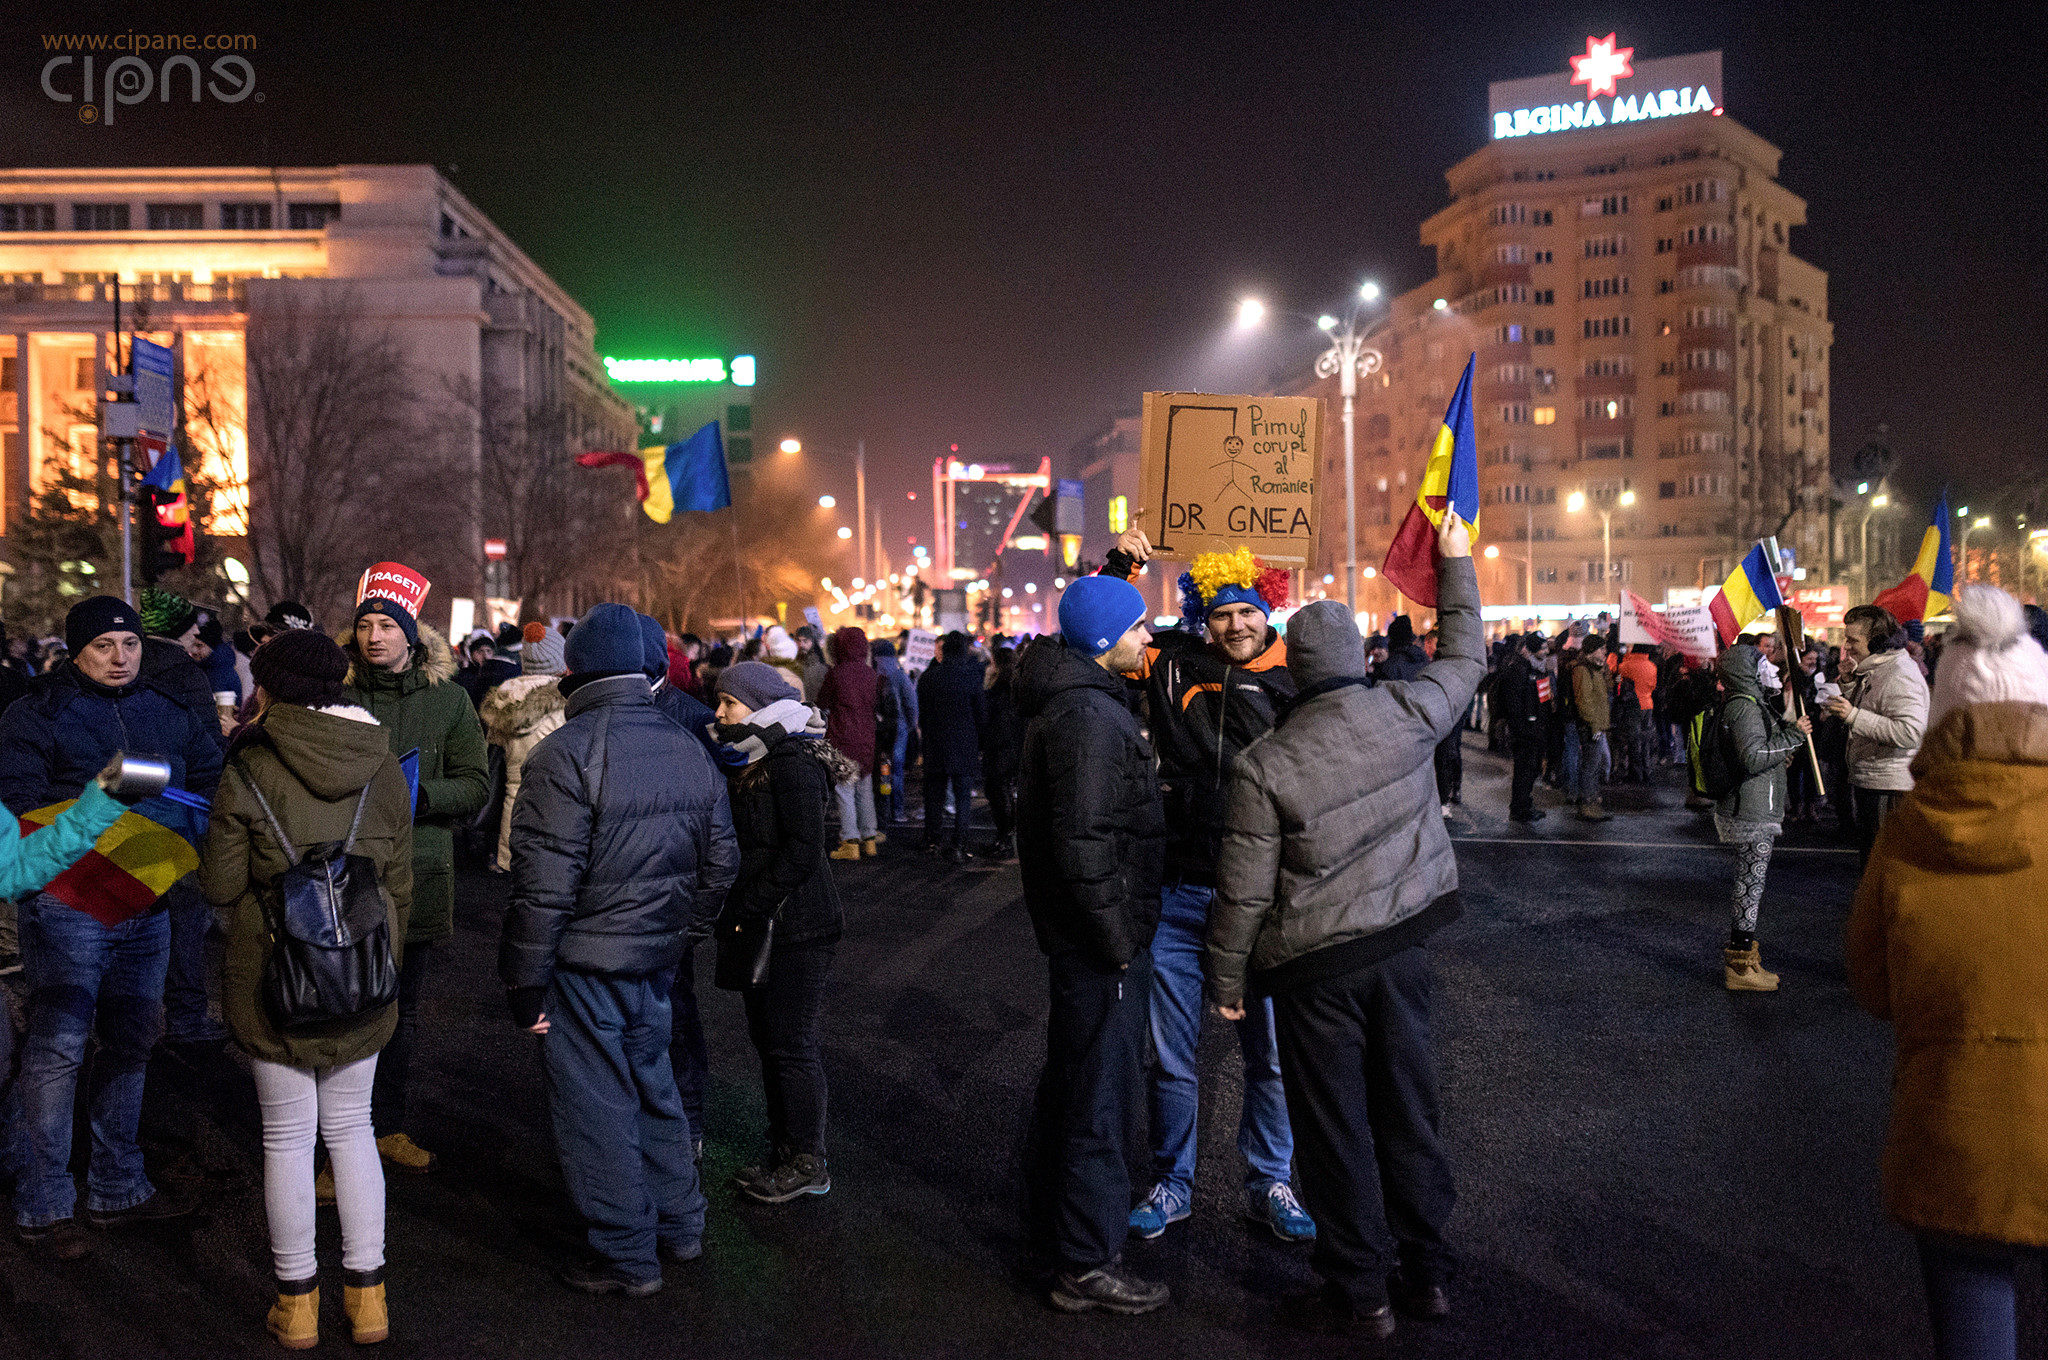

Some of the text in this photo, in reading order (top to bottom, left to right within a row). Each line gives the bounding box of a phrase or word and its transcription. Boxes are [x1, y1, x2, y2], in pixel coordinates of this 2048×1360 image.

[1493, 85, 1715, 139] REGINA MARIA
[1247, 404, 1308, 437] Primul
[1253, 431, 1308, 461] corupt
[1275, 455, 1289, 475] al
[1168, 502, 1312, 535] DR GNEA
